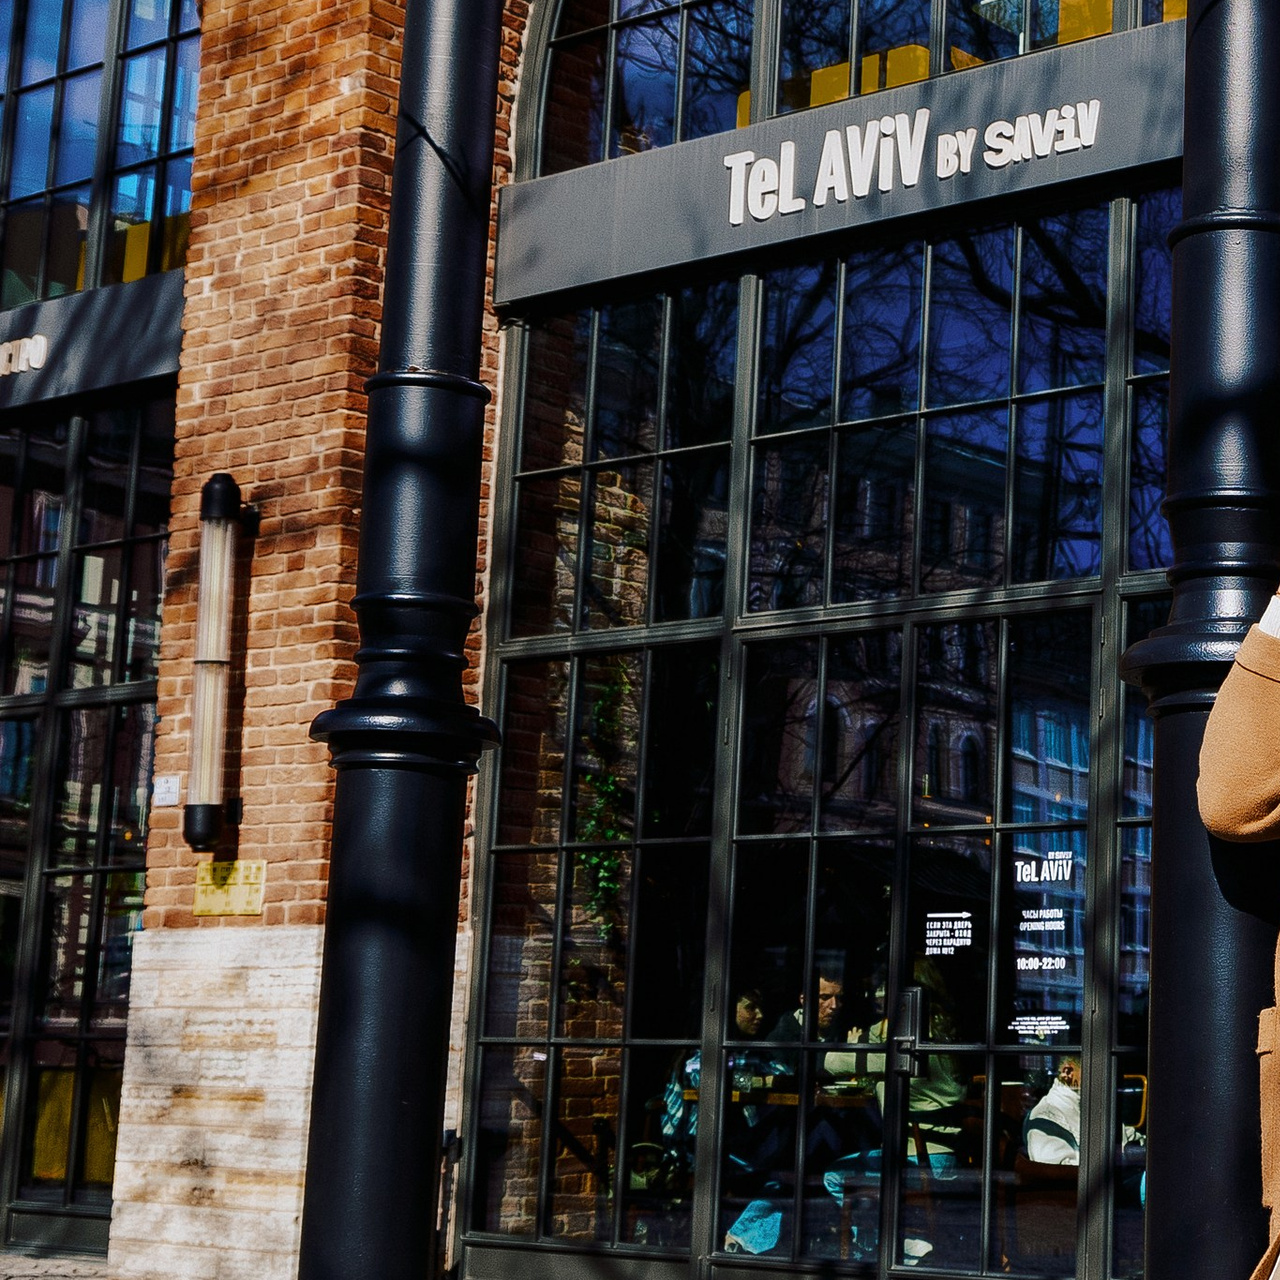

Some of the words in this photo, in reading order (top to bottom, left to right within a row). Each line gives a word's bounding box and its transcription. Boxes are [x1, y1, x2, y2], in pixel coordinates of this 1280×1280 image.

[937, 127, 977, 179] BY
[1022, 910, 1038, 919] ЧАСЫ
[1039, 909, 1063, 919] РАБОТЫ
[1020, 921, 1044, 931] OPENING
[1045, 920, 1065, 931] HOURS
[1016, 957, 1066, 970] 10:00-22:00
